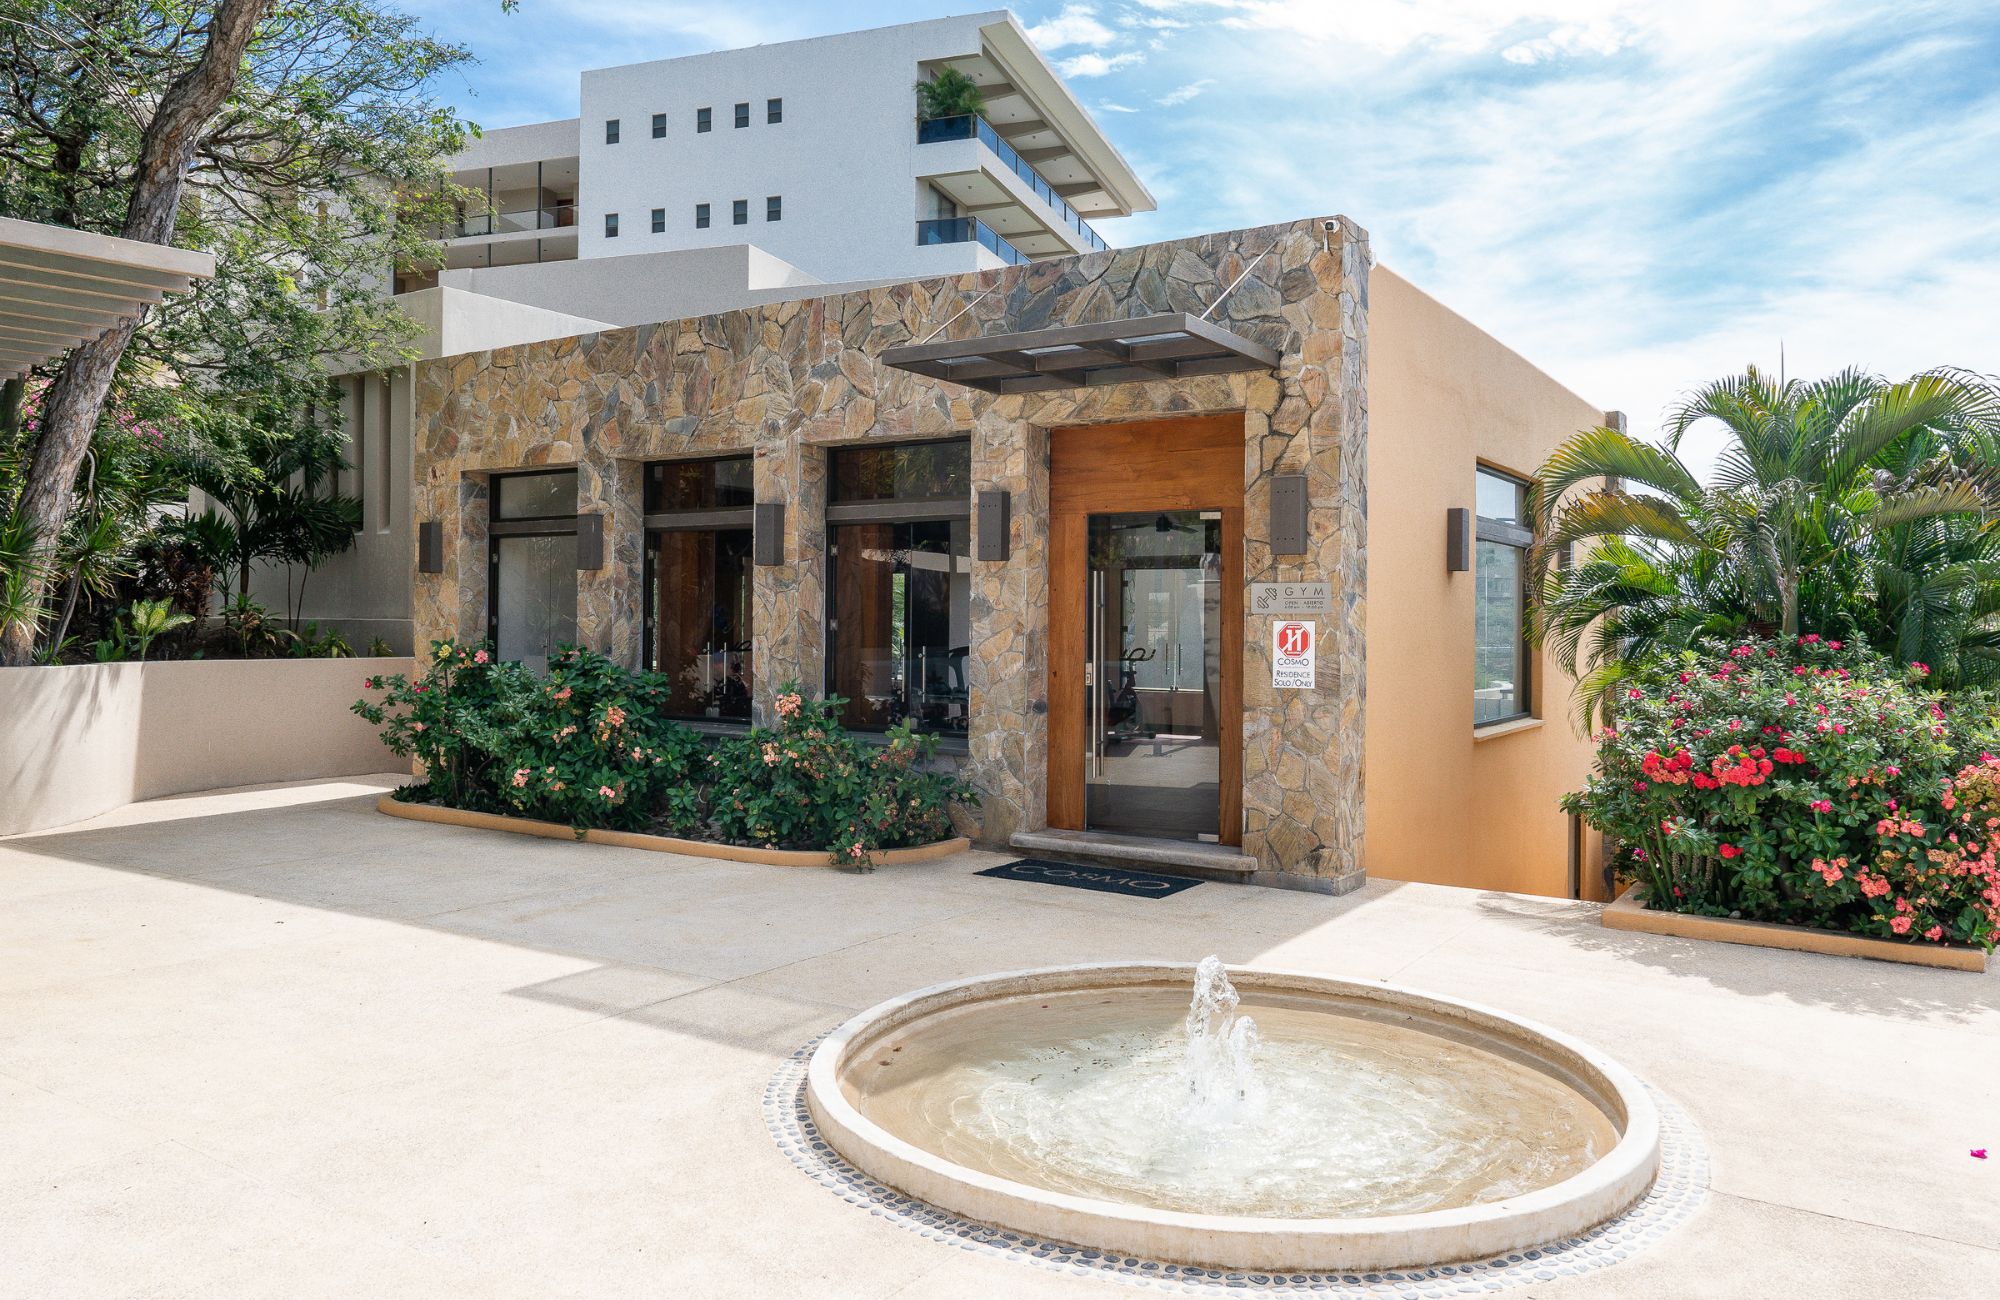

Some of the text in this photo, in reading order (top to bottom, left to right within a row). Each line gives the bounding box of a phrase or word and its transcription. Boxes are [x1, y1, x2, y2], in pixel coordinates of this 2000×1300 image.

[1284, 586, 1324, 597] GYM
[1277, 658, 1309, 667] COSMO
[1276, 669, 1311, 678] RESIDENCE
[1010, 865, 1171, 890] COSMO
